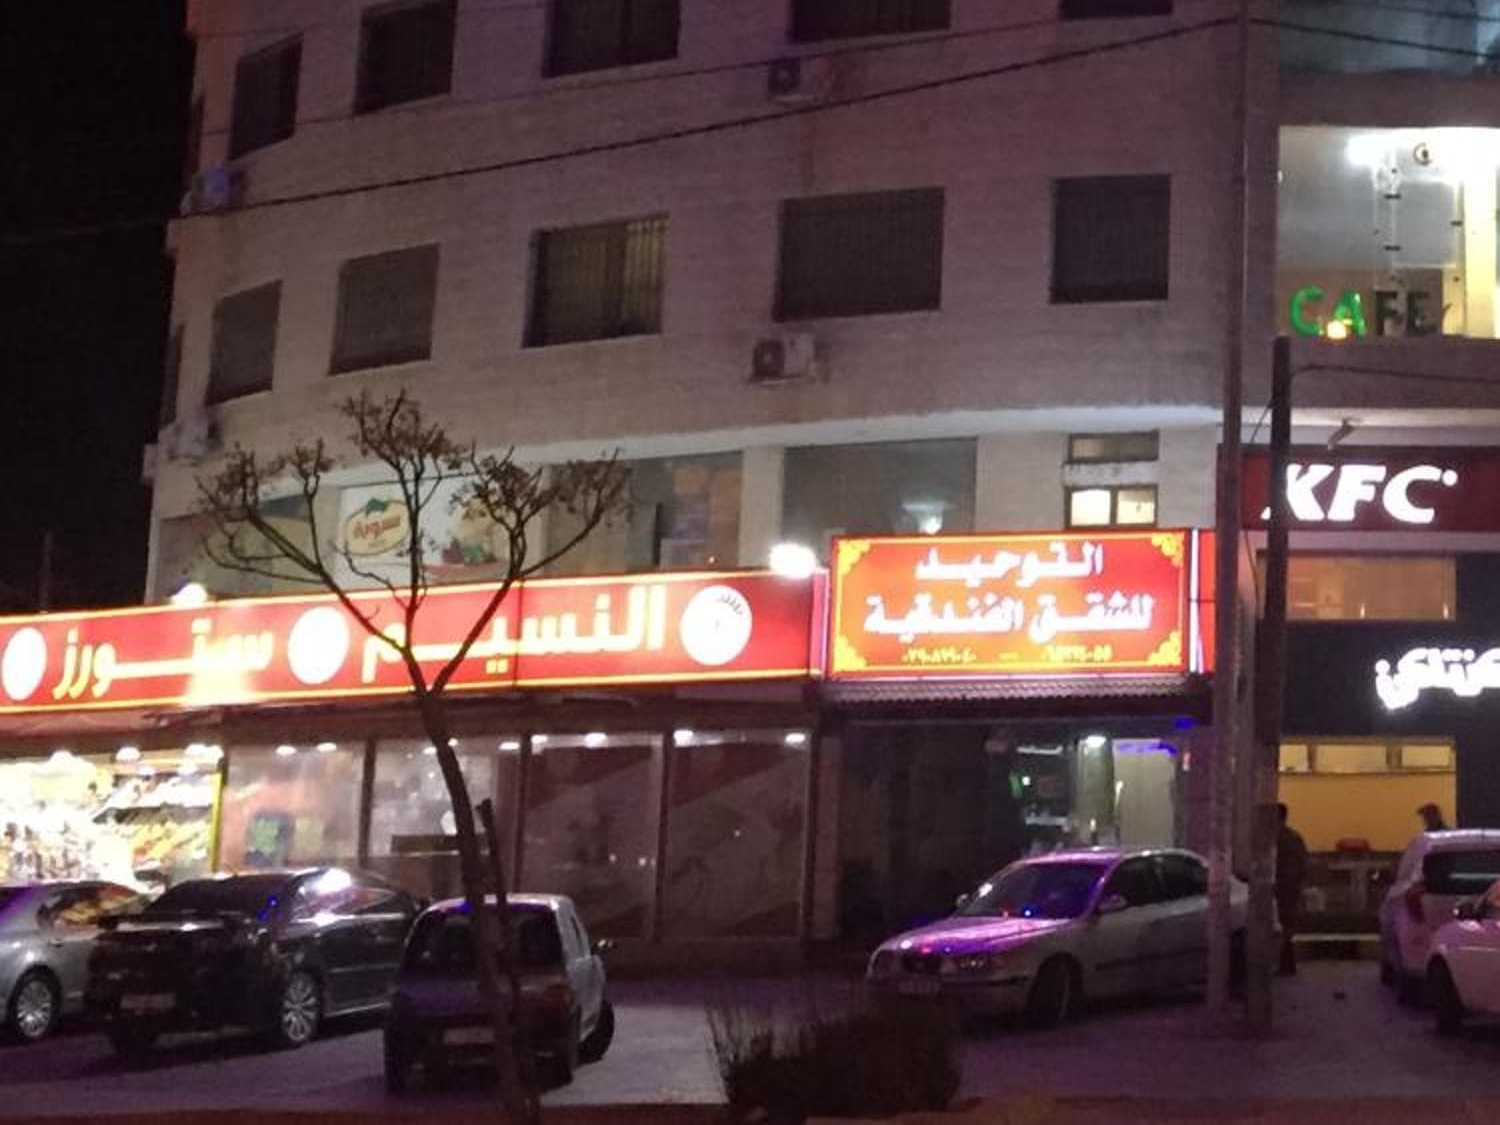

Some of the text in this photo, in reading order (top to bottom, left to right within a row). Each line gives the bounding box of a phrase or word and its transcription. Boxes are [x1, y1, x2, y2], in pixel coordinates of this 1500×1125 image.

[1289, 284, 1438, 338] CAFE
[1261, 464, 1443, 524] KFC
[915, 541, 1103, 588] التوحيد
[53, 584, 666, 700] النسيم ستورز
[864, 590, 1154, 644] للشقق الفندقية
